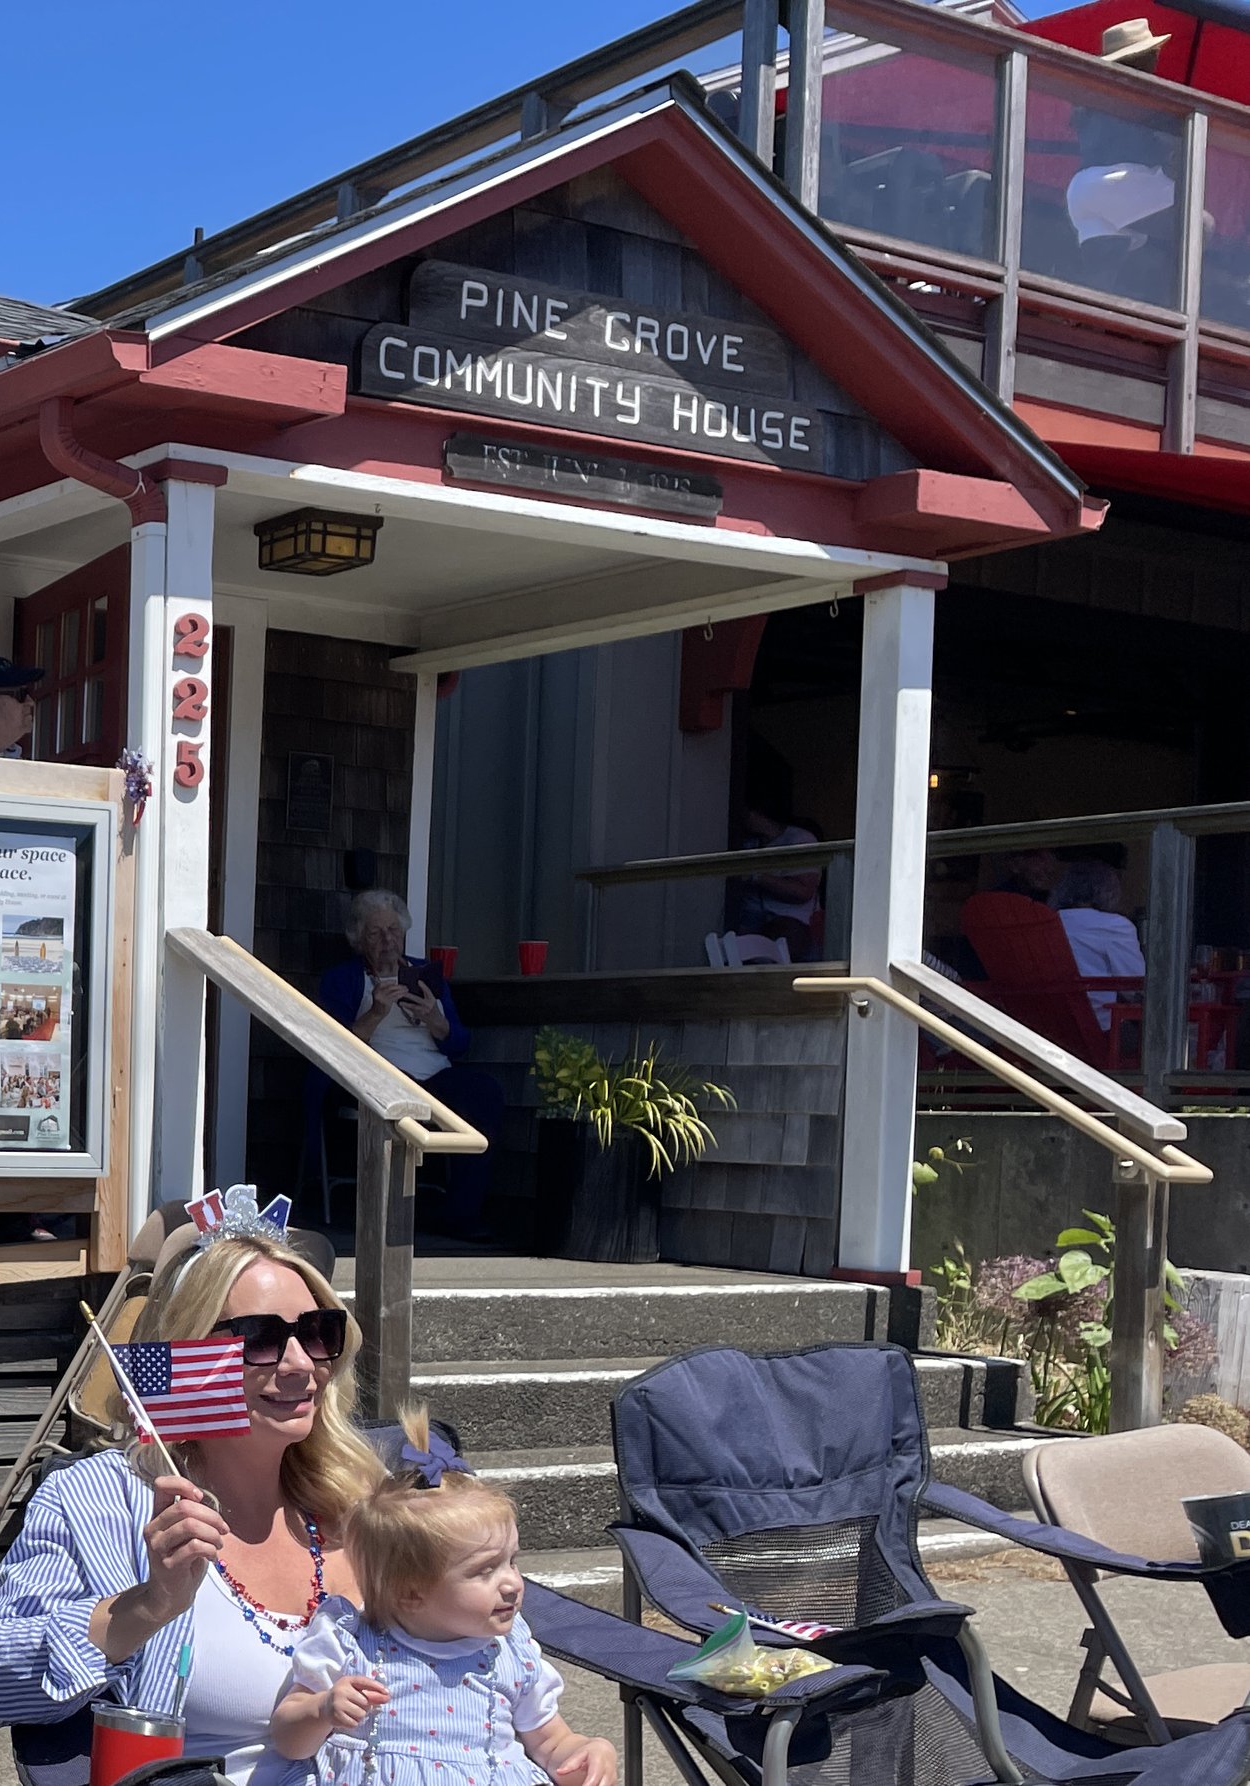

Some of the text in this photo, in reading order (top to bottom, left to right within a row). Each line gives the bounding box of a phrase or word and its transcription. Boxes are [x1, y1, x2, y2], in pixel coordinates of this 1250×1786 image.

[461, 280, 744, 372] PINE GROVE
[379, 336, 811, 451] COMMUNITY HOUSE
[174, 613, 210, 788] 225
[20, 849, 67, 864] space
[184, 1184, 293, 1236] USA
